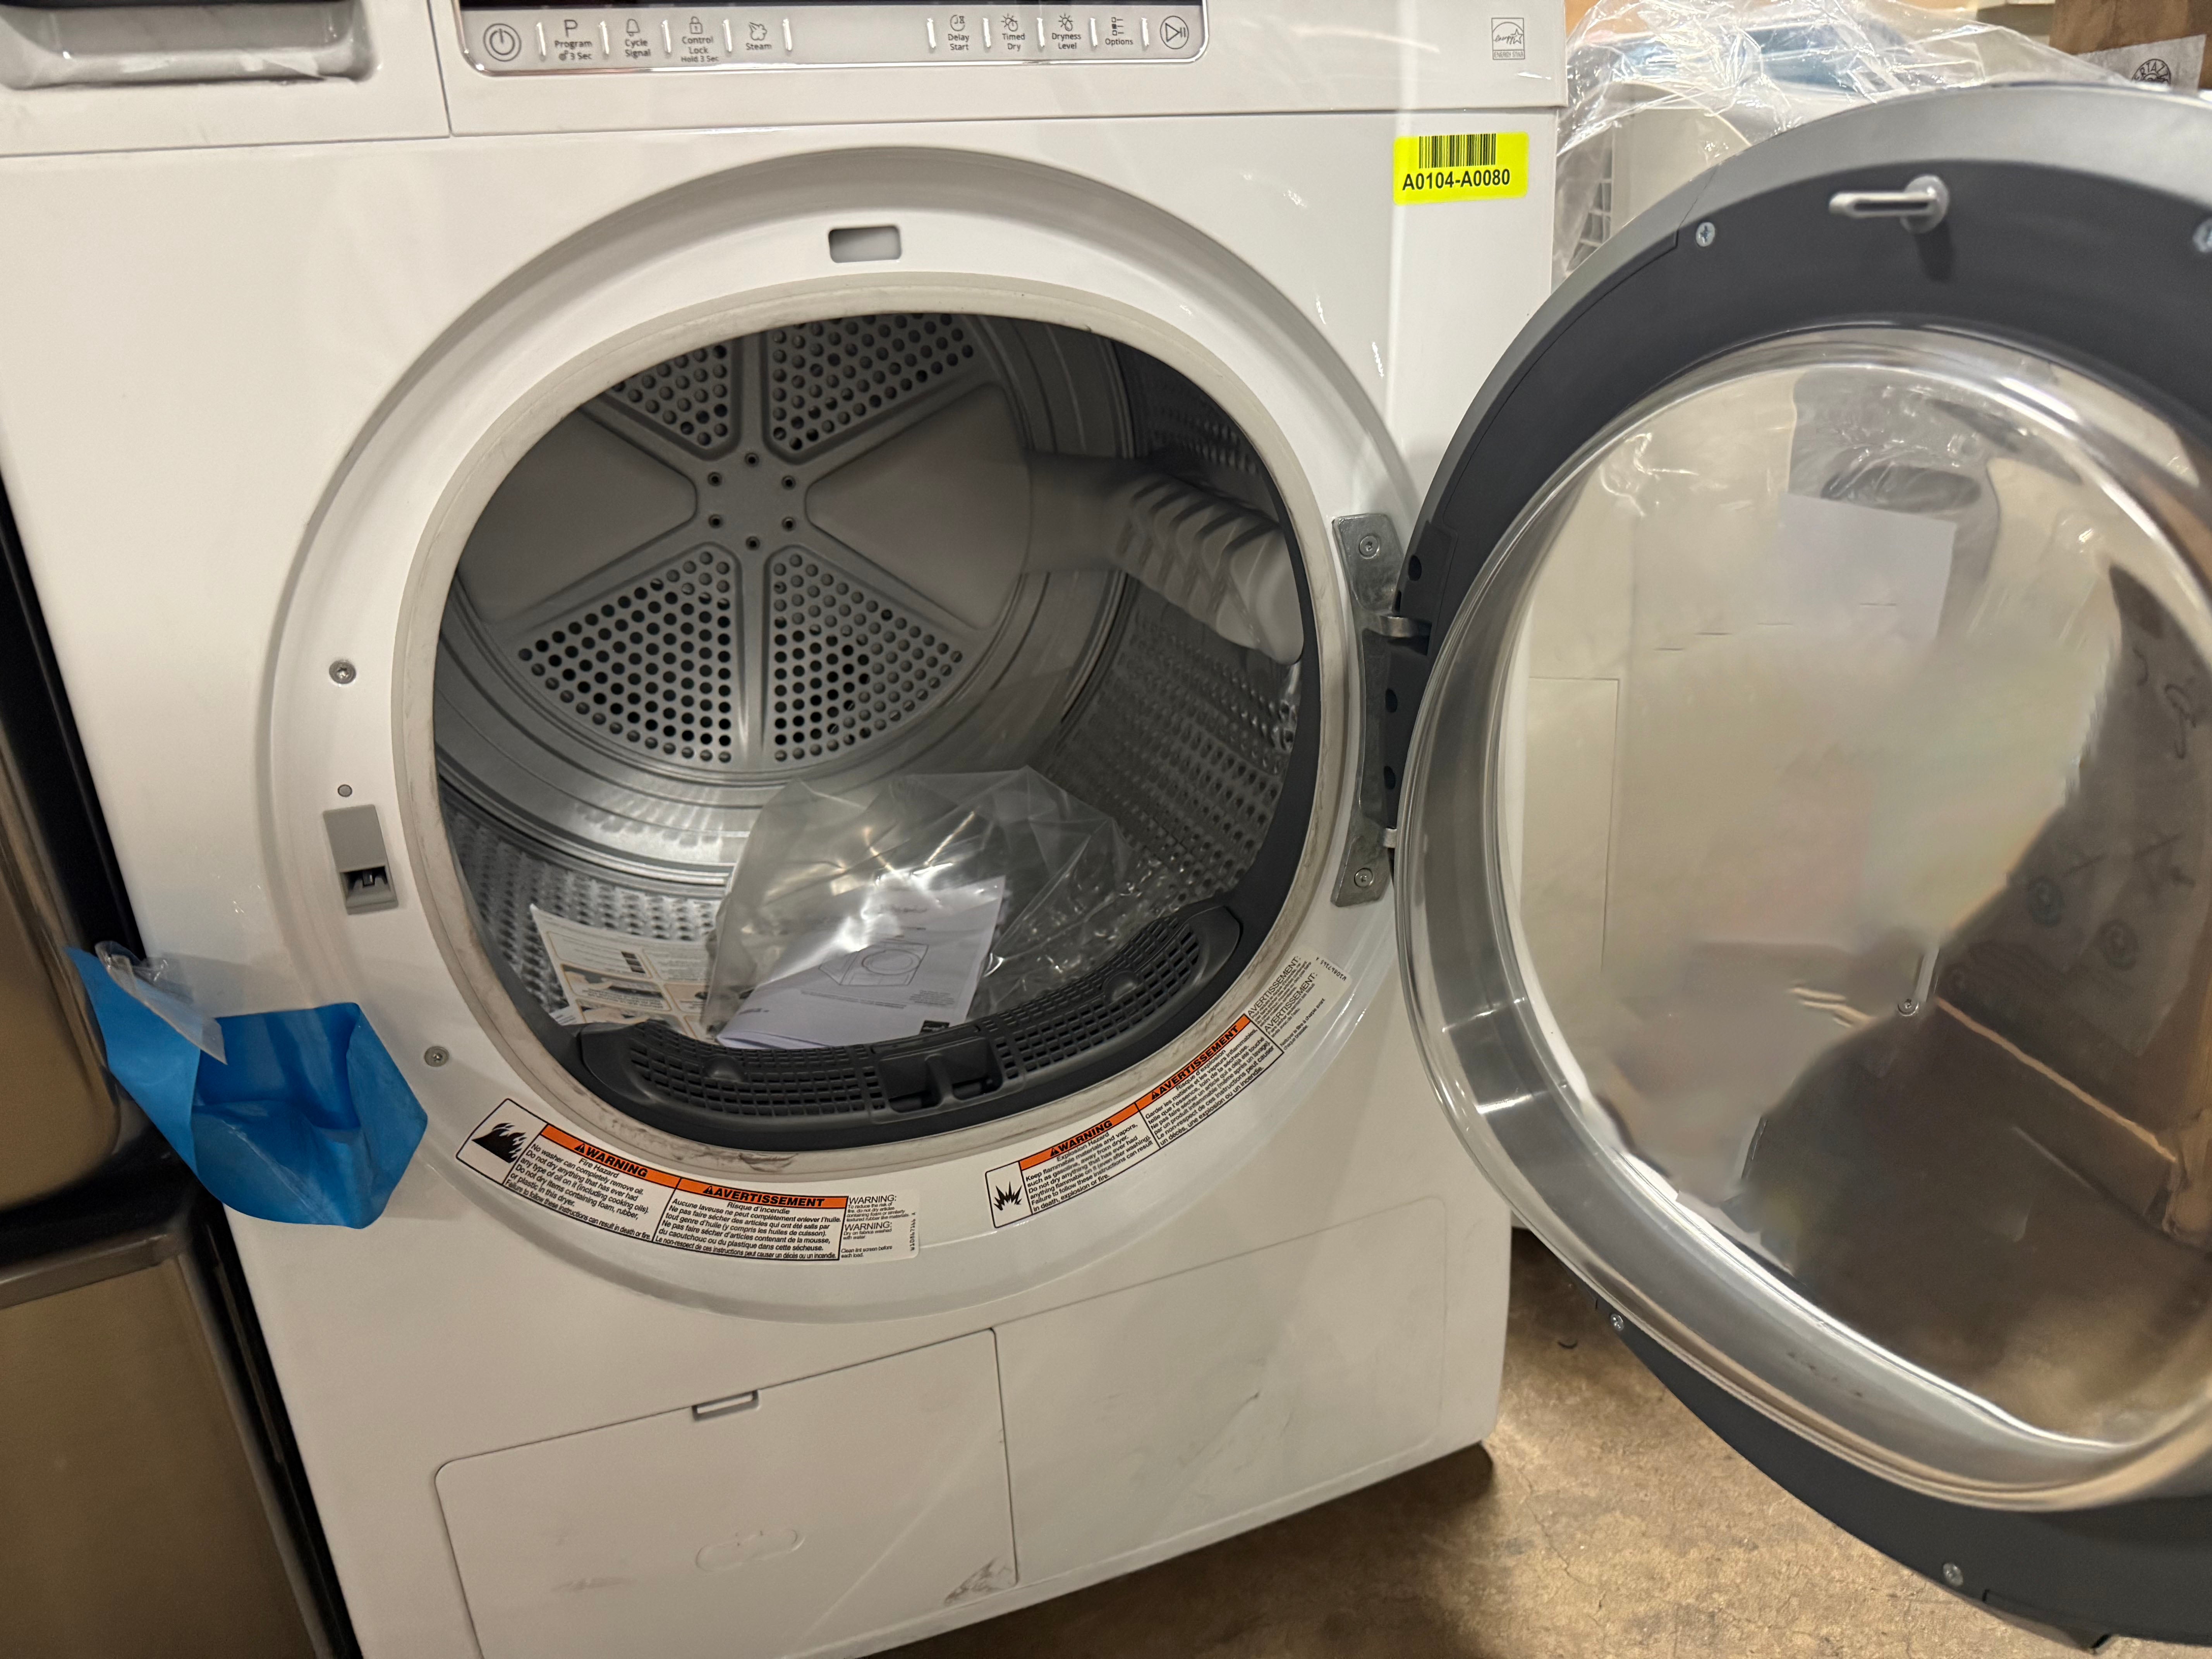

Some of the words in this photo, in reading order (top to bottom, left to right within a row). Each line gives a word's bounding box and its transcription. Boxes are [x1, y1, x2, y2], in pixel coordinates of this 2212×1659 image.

[555, 41, 592, 50] Program
[625, 39, 648, 48] Cycle
[682, 36, 714, 45] Control
[948, 33, 969, 43] Delay
[1007, 43, 1021, 52] Dry
[1052, 33, 1082, 41] Dryness
[1105, 38, 1134, 46] Options
[625, 49, 651, 59] Signal
[1402, 168, 1510, 191] A0104-A0080
[1248, 956, 1301, 1017] AVERTISSEMENT:
[1264, 972, 1317, 1033] AVERTISSEMENT:
[1159, 1025, 1239, 1095] AVERTISSEMENT
[1174, 1075, 1195, 1091] Risque
[1195, 1050, 1226, 1075] d'explosion
[1158, 1138, 1168, 1147] un
[1187, 1118, 1198, 1127] une
[1199, 1098, 1225, 1121] explosion
[1240, 1067, 1264, 1086] incendie.
[1056, 1144, 1087, 1161] Explosion
[1087, 1131, 1109, 1146] Hazard
[1058, 1120, 1113, 1152] WARNING
[531, 1143, 541, 1152] No
[541, 1150, 563, 1162] washer
[575, 1166, 610, 1184] completely
[610, 1180, 634, 1192] remove
[587, 1147, 648, 1177] WARNING
[1025, 1172, 1042, 1182] Keep
[1043, 1158, 1074, 1174] flammable
[1075, 1143, 1103, 1159] materials
[1103, 1135, 1115, 1145] and
[1115, 1123, 1137, 1137] vapors,
[1027, 1178, 1042, 1187] such
[1053, 1162, 1080, 1178] gasoline,
[1081, 1153, 1096, 1163] away
[1097, 1145, 1111, 1154] from
[1112, 1135, 1128, 1146] dryer.
[1039, 1181, 1049, 1189] not
[1061, 1164, 1088, 1179] anything
[1088, 1157, 1100, 1166] that
[1113, 1143, 1125, 1153] ever
[1125, 1135, 1138, 1145] had
[526, 1150, 536, 1158] Do
[535, 1156, 547, 1164] not
[546, 1161, 558, 1170] dry
[557, 1167, 585, 1183] anything
[585, 1178, 598, 1187] that
[598, 1183, 610, 1192] has
[610, 1188, 625, 1197] ever
[625, 1192, 638, 1201] had
[579, 1158, 593, 1168] Fire
[593, 1164, 619, 1178] Hazard
[1030, 1186, 1055, 1199] anything
[1055, 1173, 1084, 1188] flammable
[1113, 1150, 1124, 1159] after
[1031, 1194, 1051, 1205] Failure
[1059, 1183, 1076, 1194] follow
[1077, 1175, 1092, 1185] these
[1093, 1157, 1126, 1177] instructions
[1137, 1140, 1152, 1152] result
[515, 1164, 525, 1173] Do
[525, 1170, 537, 1179] not
[536, 1176, 547, 1185] dry
[546, 1180, 565, 1192] items
[565, 1189, 597, 1206] containing
[598, 1200, 615, 1212] foam,
[616, 1208, 638, 1220] rubber,
[517, 1176, 538, 1190] plastic
[545, 1189, 557, 1199] this
[557, 1195, 575, 1207] dryer.
[520, 1158, 533, 1168] any
[532, 1163, 546, 1174] type
[576, 1183, 608, 1200] (including
[608, 1196, 634, 1209] cooking
[634, 1204, 648, 1213] oils).
[713, 1187, 825, 1207] AVERTISSEMENT
[849, 1194, 897, 1204] WARNING:
[1041, 1198, 1060, 1208] death,
[1061, 1183, 1092, 1200] explosion
[505, 1179, 523, 1192] Failure
[529, 1191, 544, 1202] follow
[544, 1198, 558, 1209] these
[558, 1204, 588, 1221] instructions
[598, 1220, 615, 1229] result
[620, 1226, 635, 1235] death
[672, 1198, 697, 1209] Aucune
[698, 1204, 723, 1213] laveuse
[727, 1202, 752, 1211] Risque
[753, 1206, 790, 1214] d'incendie
[668, 1231, 707, 1242] caoutchouc
[727, 1240, 757, 1249] plastique
[844, 1221, 892, 1231] WARNING:
